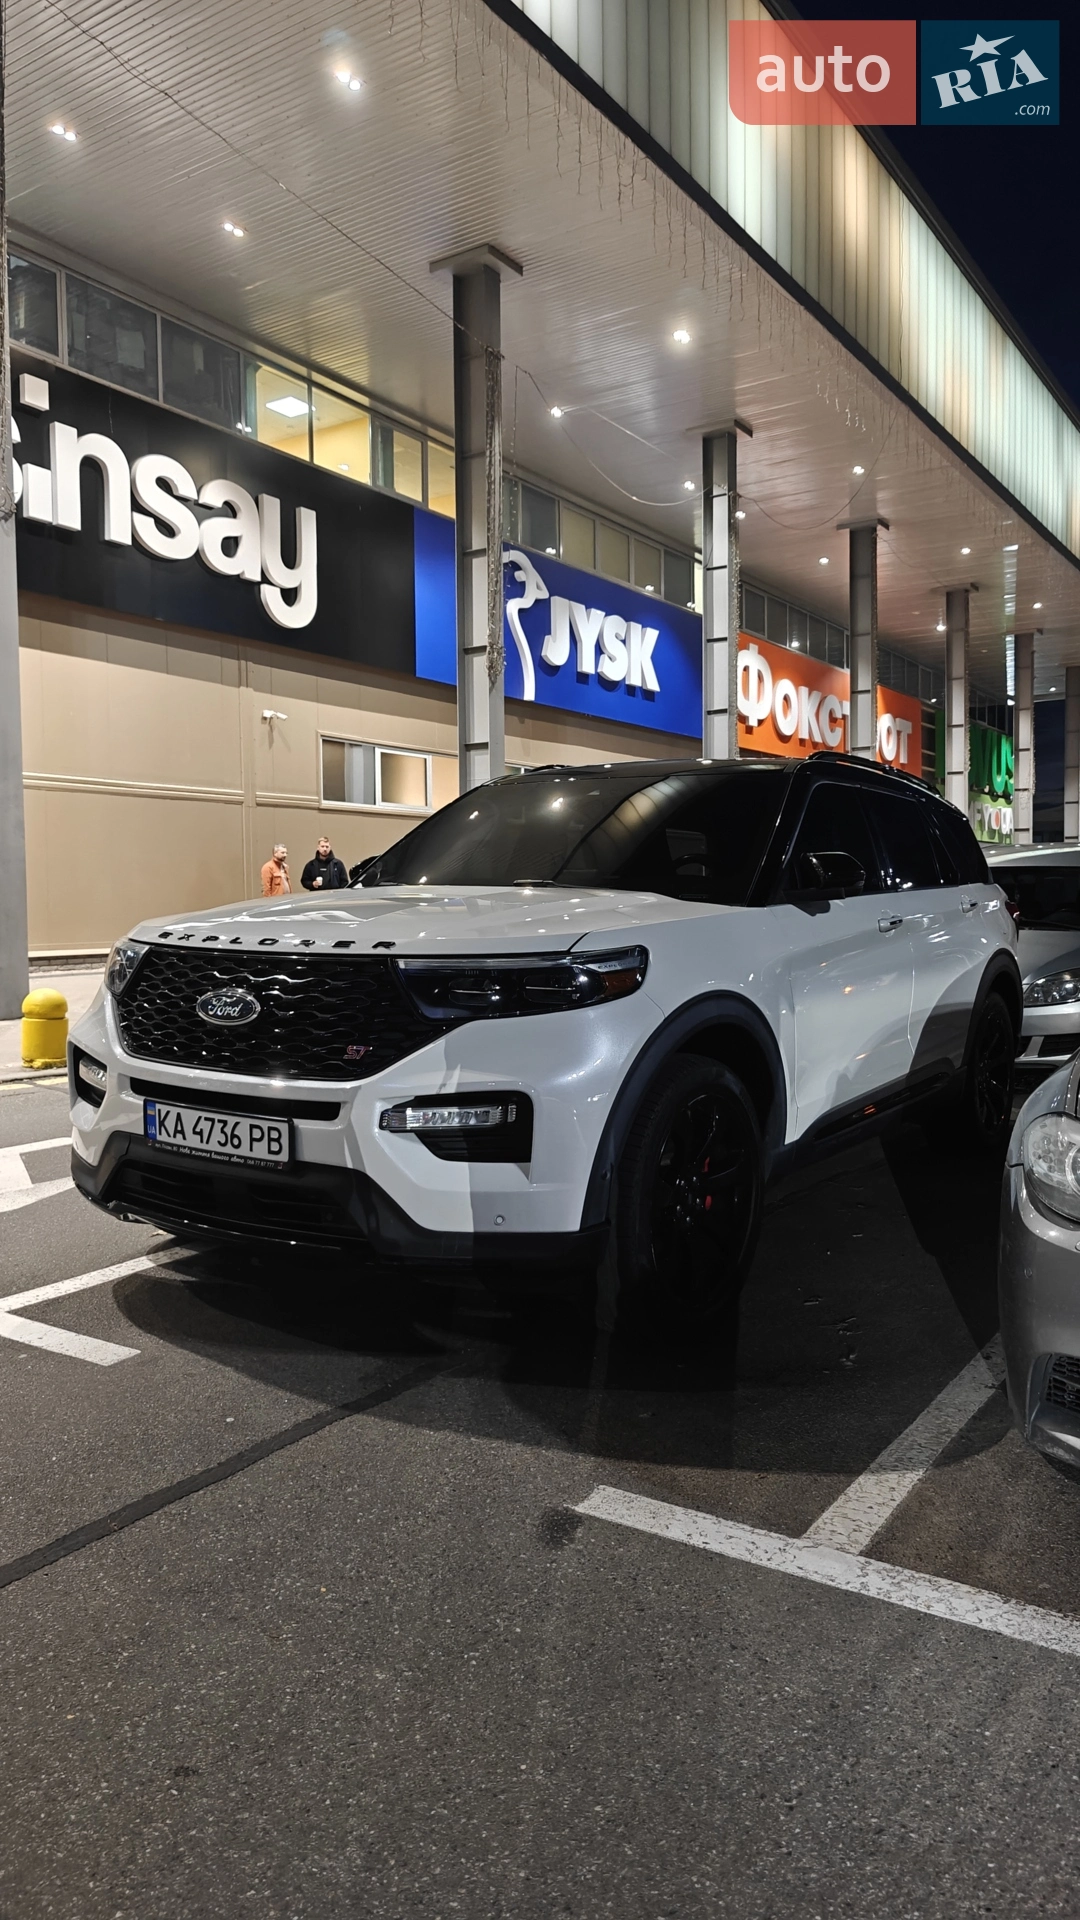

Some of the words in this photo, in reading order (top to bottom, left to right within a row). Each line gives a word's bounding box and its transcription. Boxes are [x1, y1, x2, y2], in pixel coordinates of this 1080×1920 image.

[541, 595, 661, 692] JYSK
[157, 931, 397, 950] EXPLORER
[207, 995, 244, 1017] Ford
[343, 1045, 373, 1060] ST
[147, 1125, 156, 1134] UA
[157, 1108, 187, 1141] KA
[192, 1115, 242, 1150] 4736
[249, 1123, 283, 1156] PB
